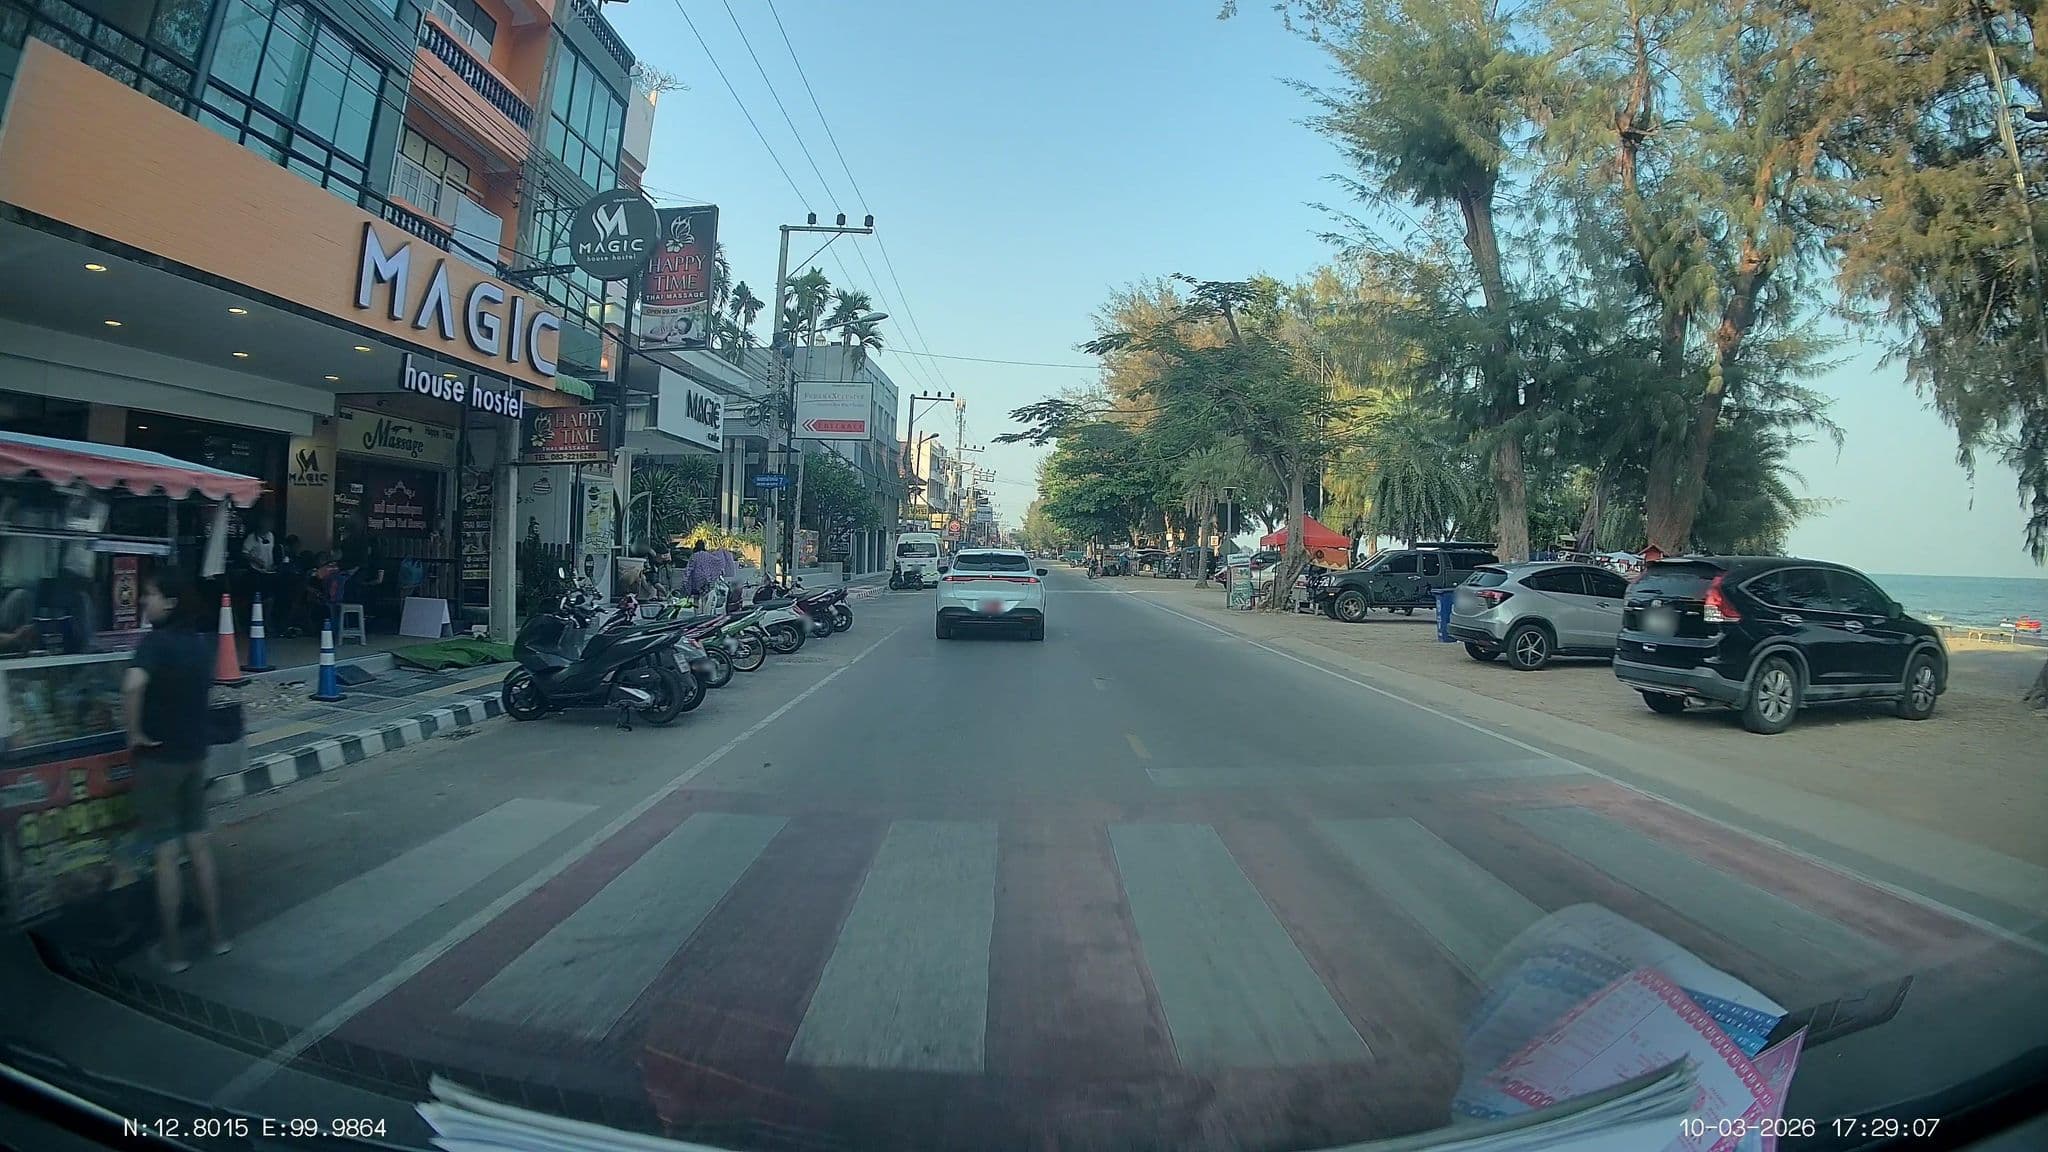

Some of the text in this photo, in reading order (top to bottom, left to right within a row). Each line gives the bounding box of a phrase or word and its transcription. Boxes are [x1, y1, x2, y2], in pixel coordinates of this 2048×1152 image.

[579, 239, 645, 254] MAGIC
[649, 255, 706, 273] HAPPY
[654, 274, 698, 291] TIME
[354, 221, 560, 377] MAGIC
[403, 353, 523, 420] house hostel
[554, 411, 607, 428] HAPPY
[363, 417, 424, 458] Massage
[561, 428, 600, 444] TIME
[288, 472, 329, 483] MAGIC
